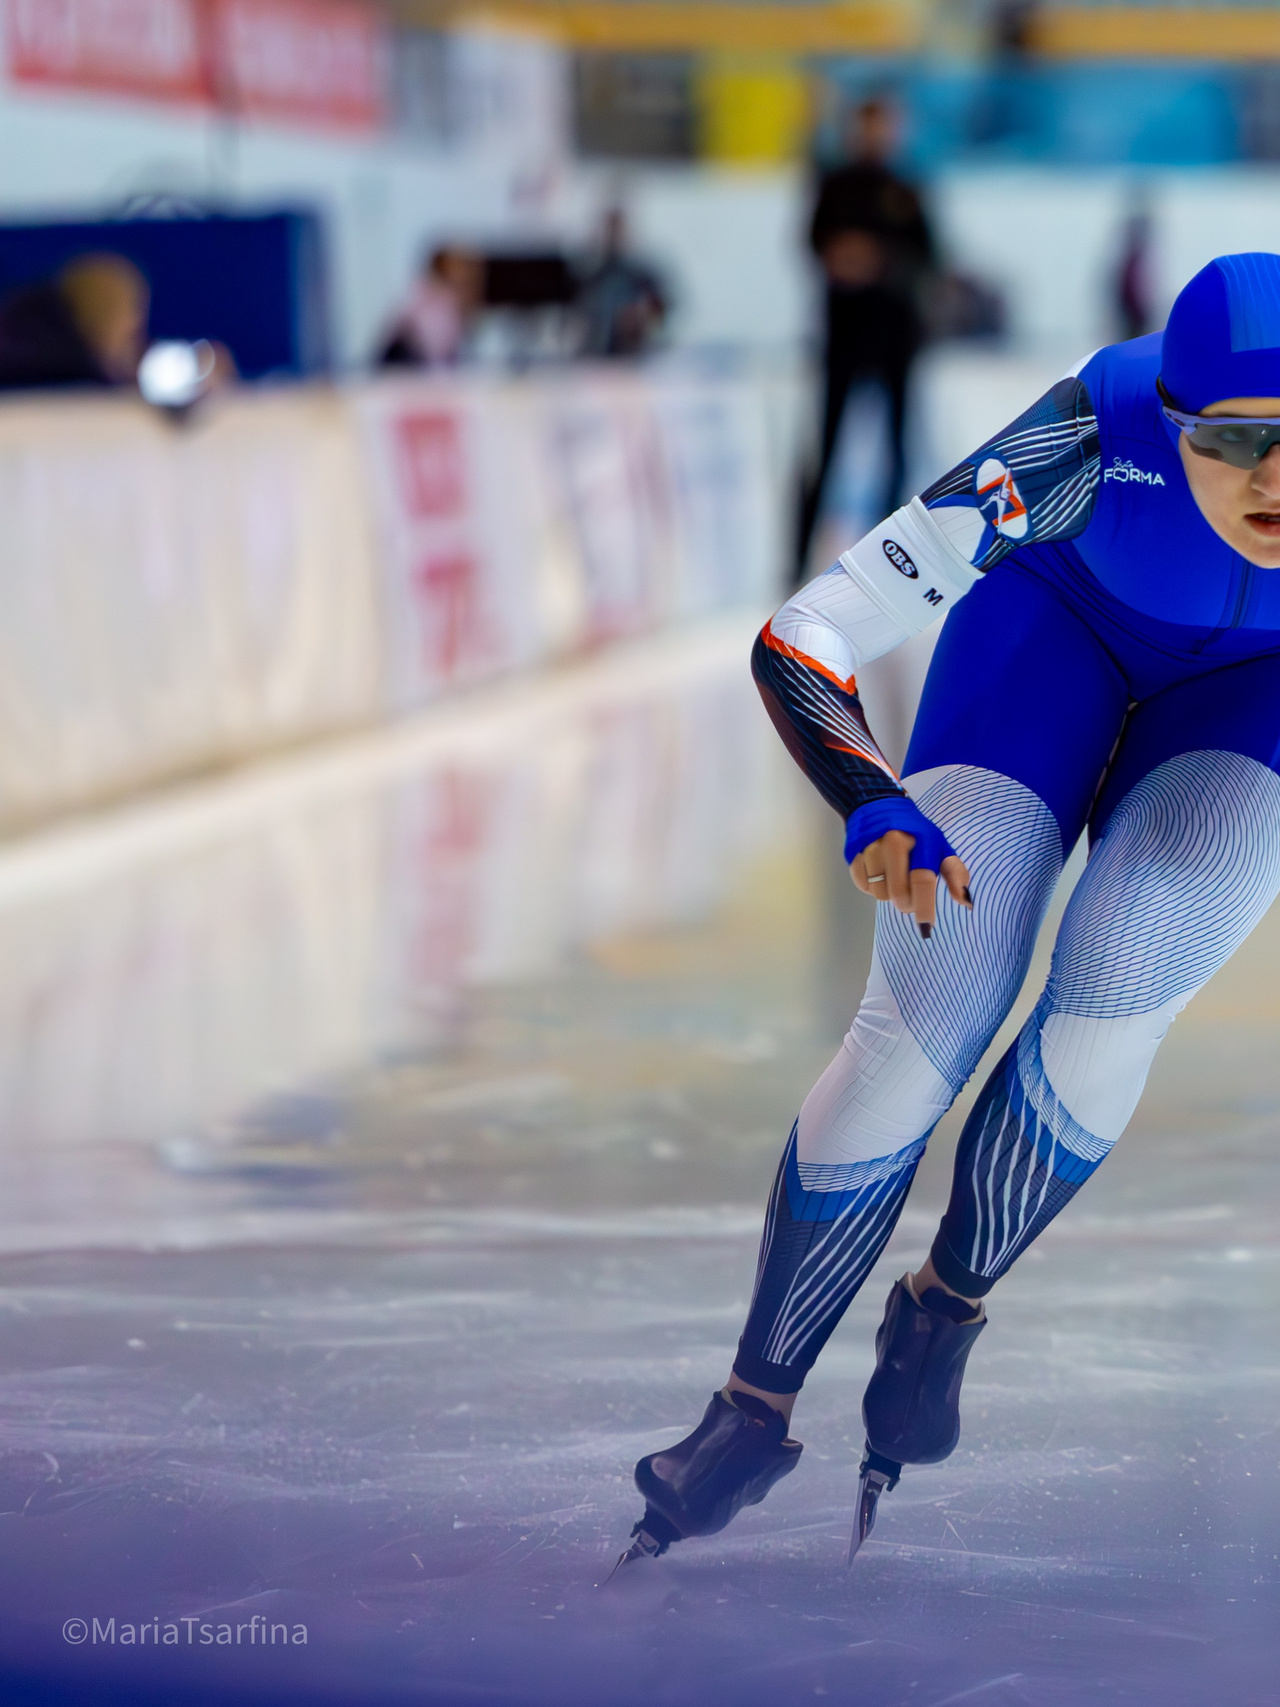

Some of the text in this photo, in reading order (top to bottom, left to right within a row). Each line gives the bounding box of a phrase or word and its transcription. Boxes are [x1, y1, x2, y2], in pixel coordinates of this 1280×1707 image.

[1104, 467, 1165, 486] FORMA
[883, 541, 915, 577] OBS
[923, 588, 944, 606] M
